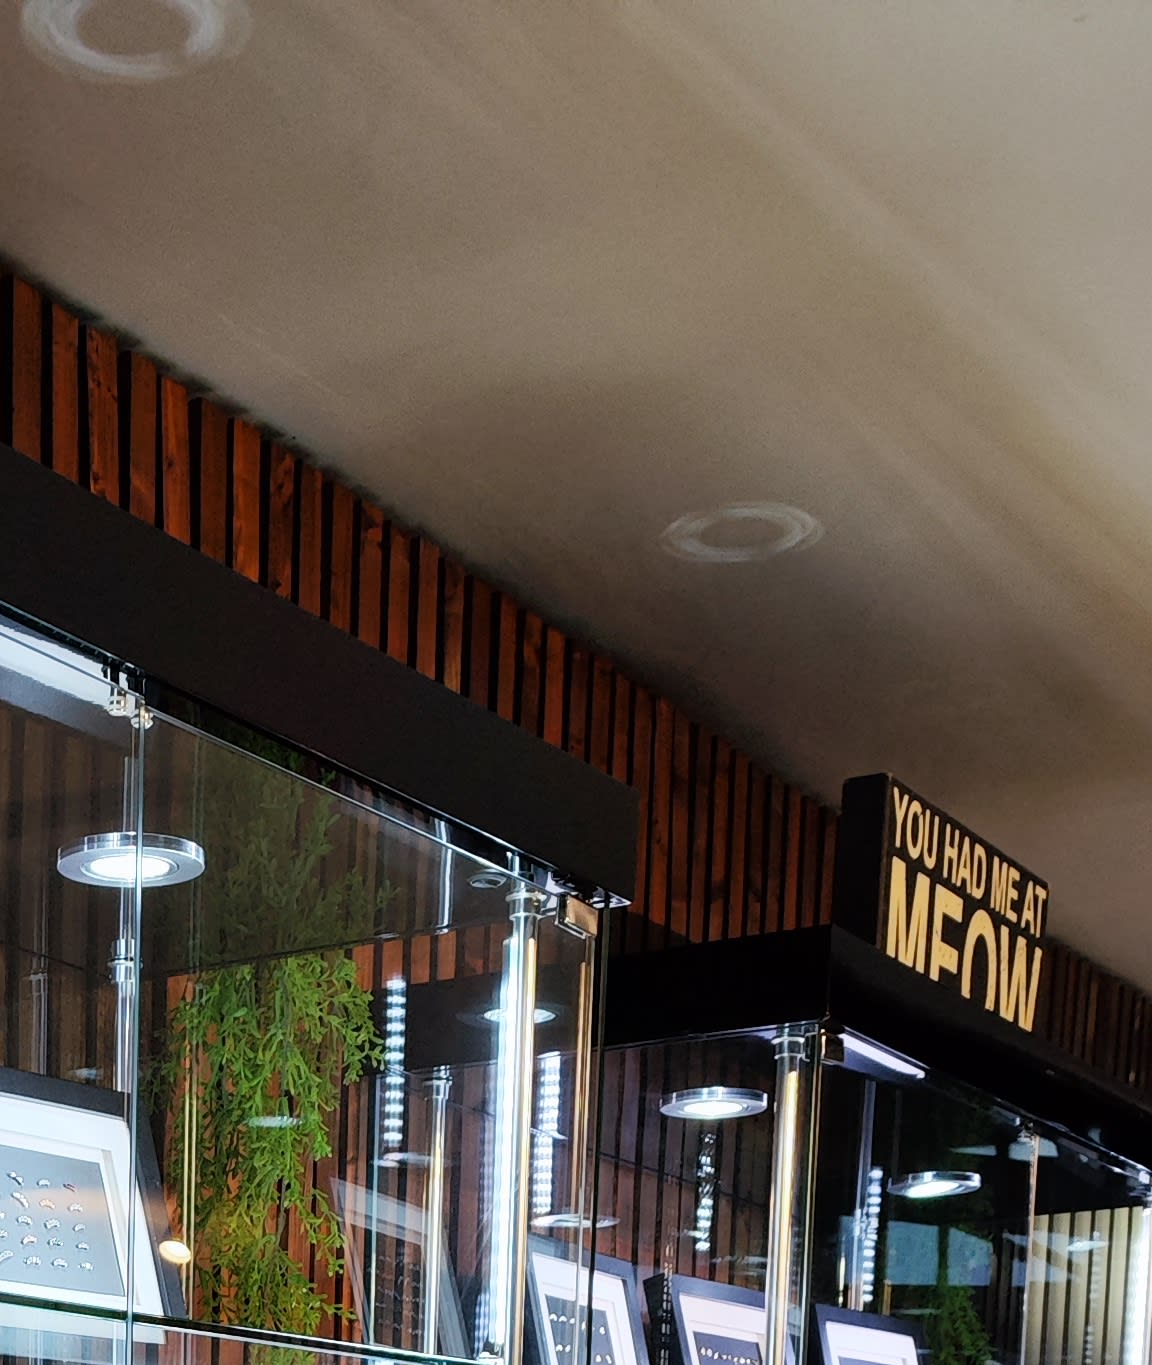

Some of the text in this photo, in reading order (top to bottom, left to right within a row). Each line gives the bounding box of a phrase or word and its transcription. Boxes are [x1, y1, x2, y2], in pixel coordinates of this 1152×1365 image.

[893, 787, 1047, 938] YOU HAD ME AT
